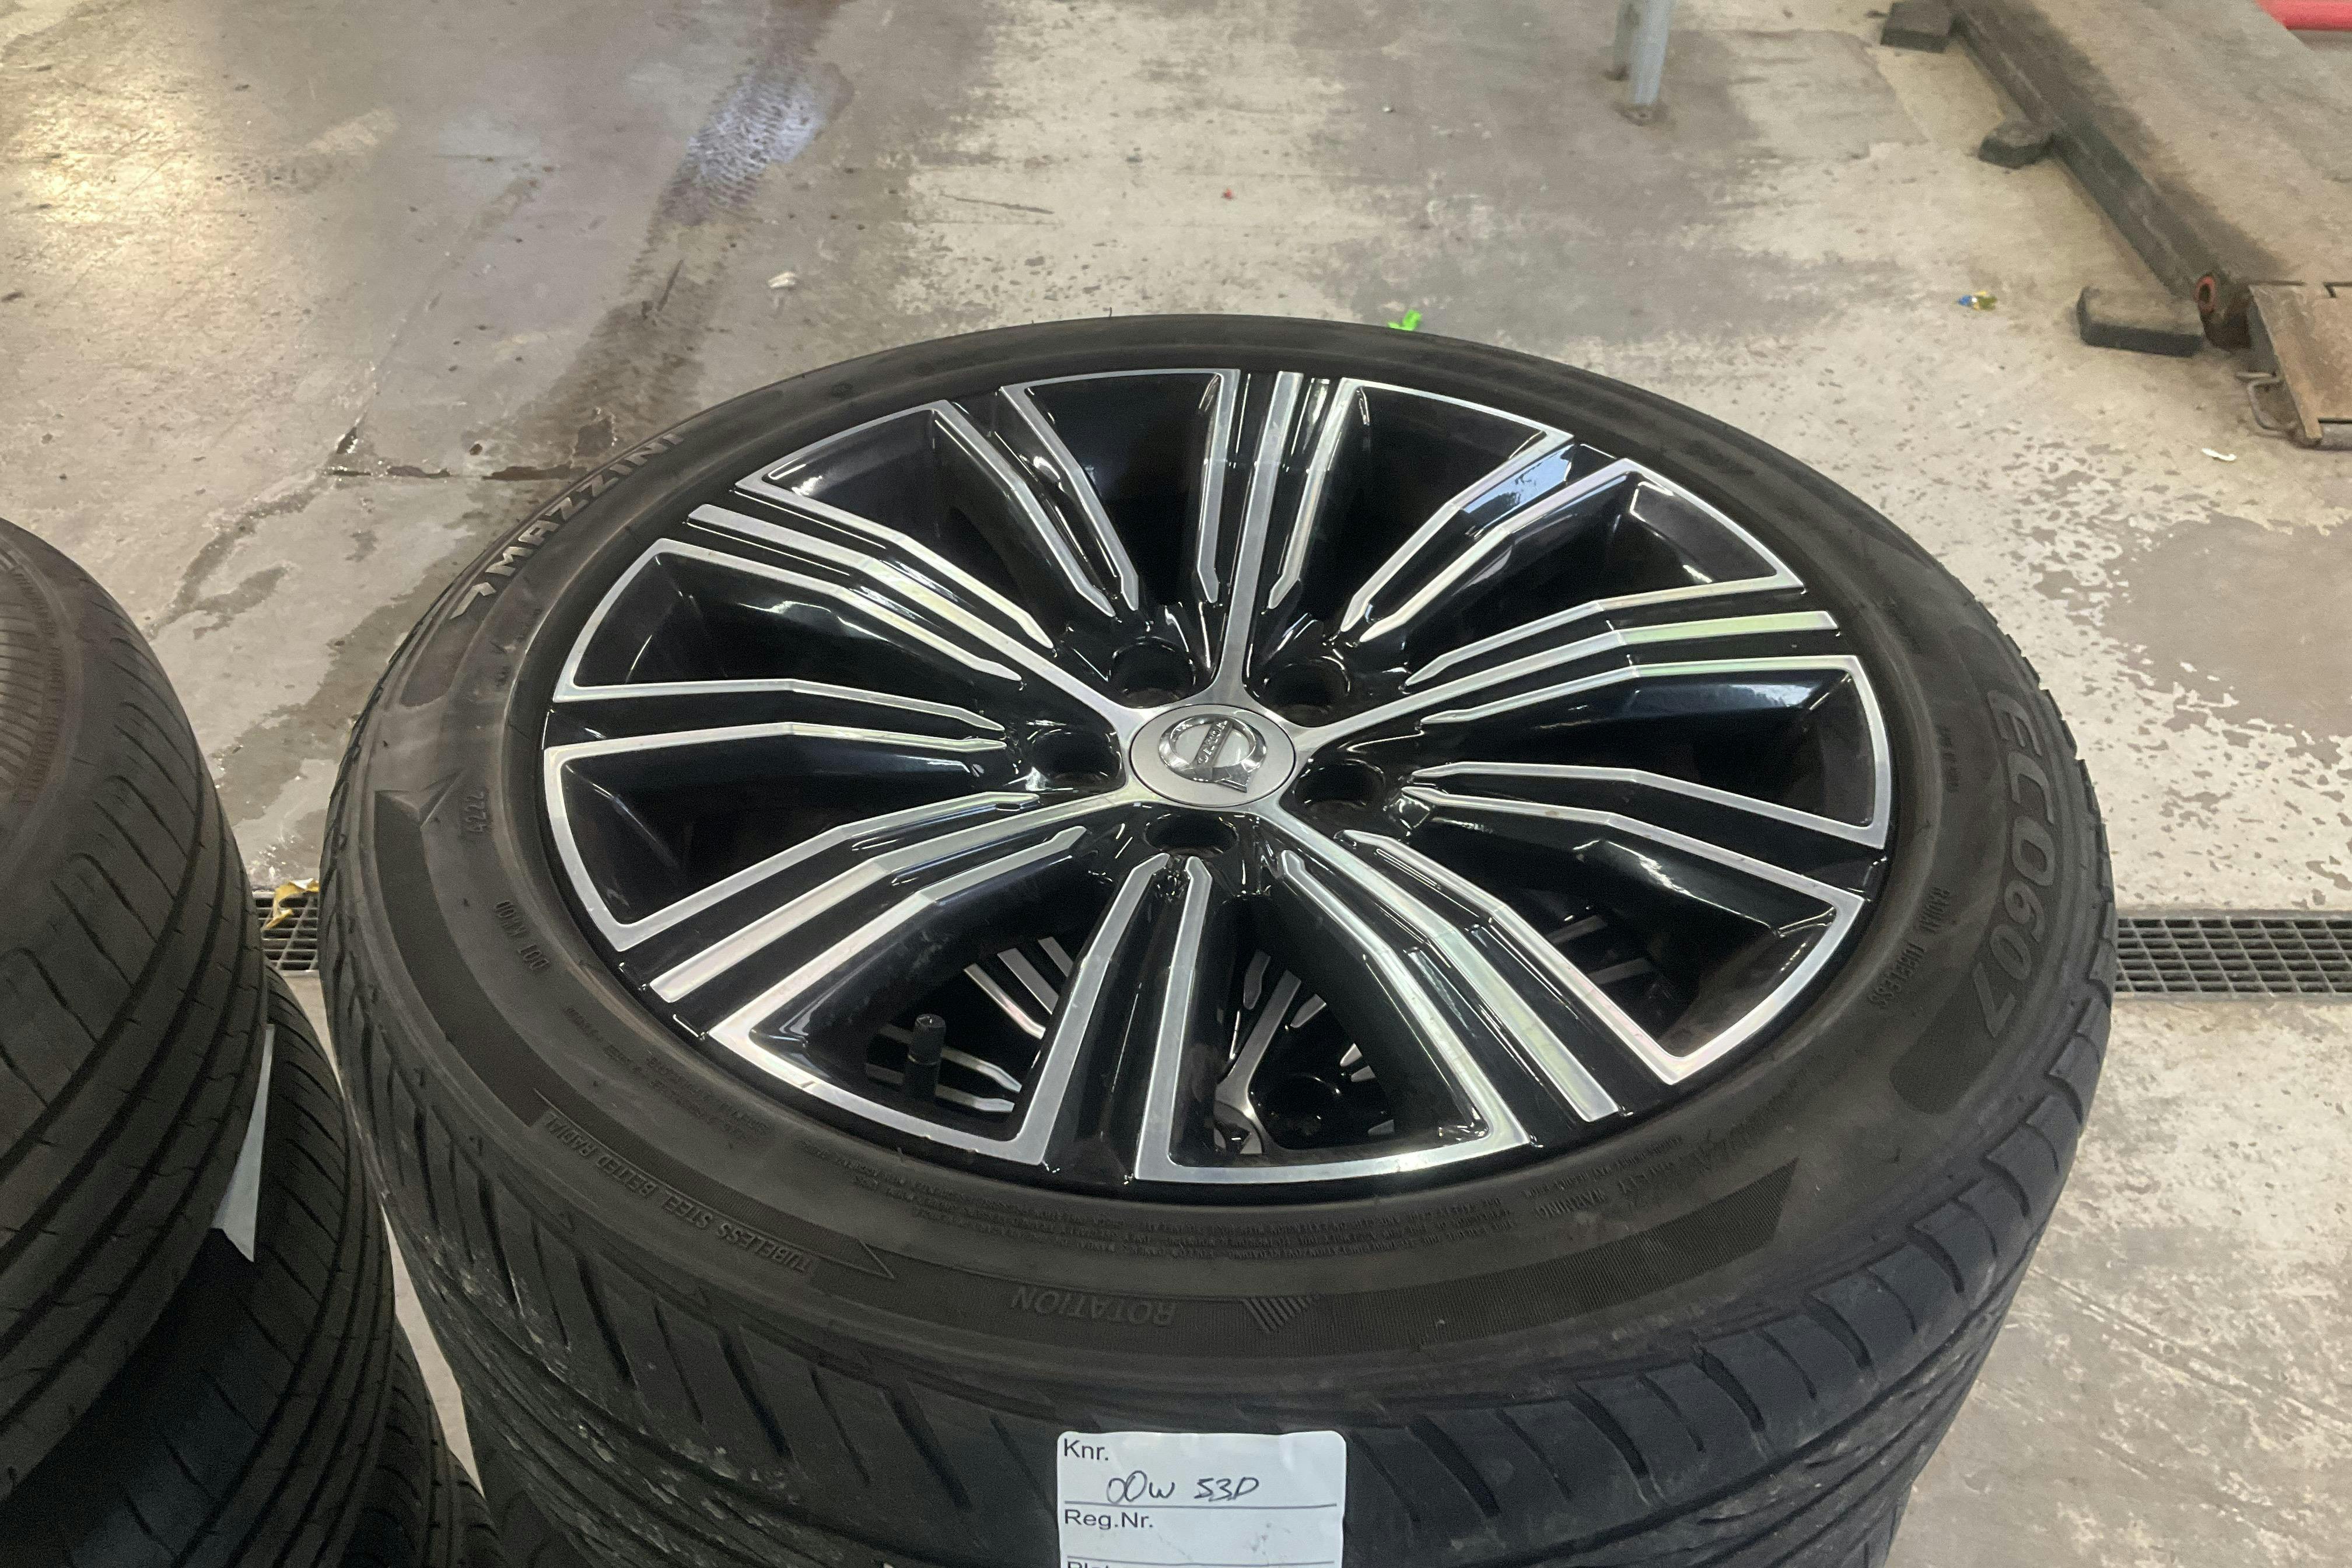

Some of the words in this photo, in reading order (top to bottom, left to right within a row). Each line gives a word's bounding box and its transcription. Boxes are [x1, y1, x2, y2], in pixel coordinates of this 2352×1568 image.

[485, 433, 684, 577] MAZZINI
[1973, 690, 2055, 1038] ECO607
[545, 1111, 599, 1158] RADIAL
[596, 1152, 659, 1199] BELTED
[662, 1189, 713, 1228] STEEL
[717, 1223, 812, 1274] TUBELESS
[1012, 1285, 1178, 1326] ROTATION
[1064, 1438, 1108, 1461] Knr.
[1065, 1508, 1153, 1530] Reg.Nr.
